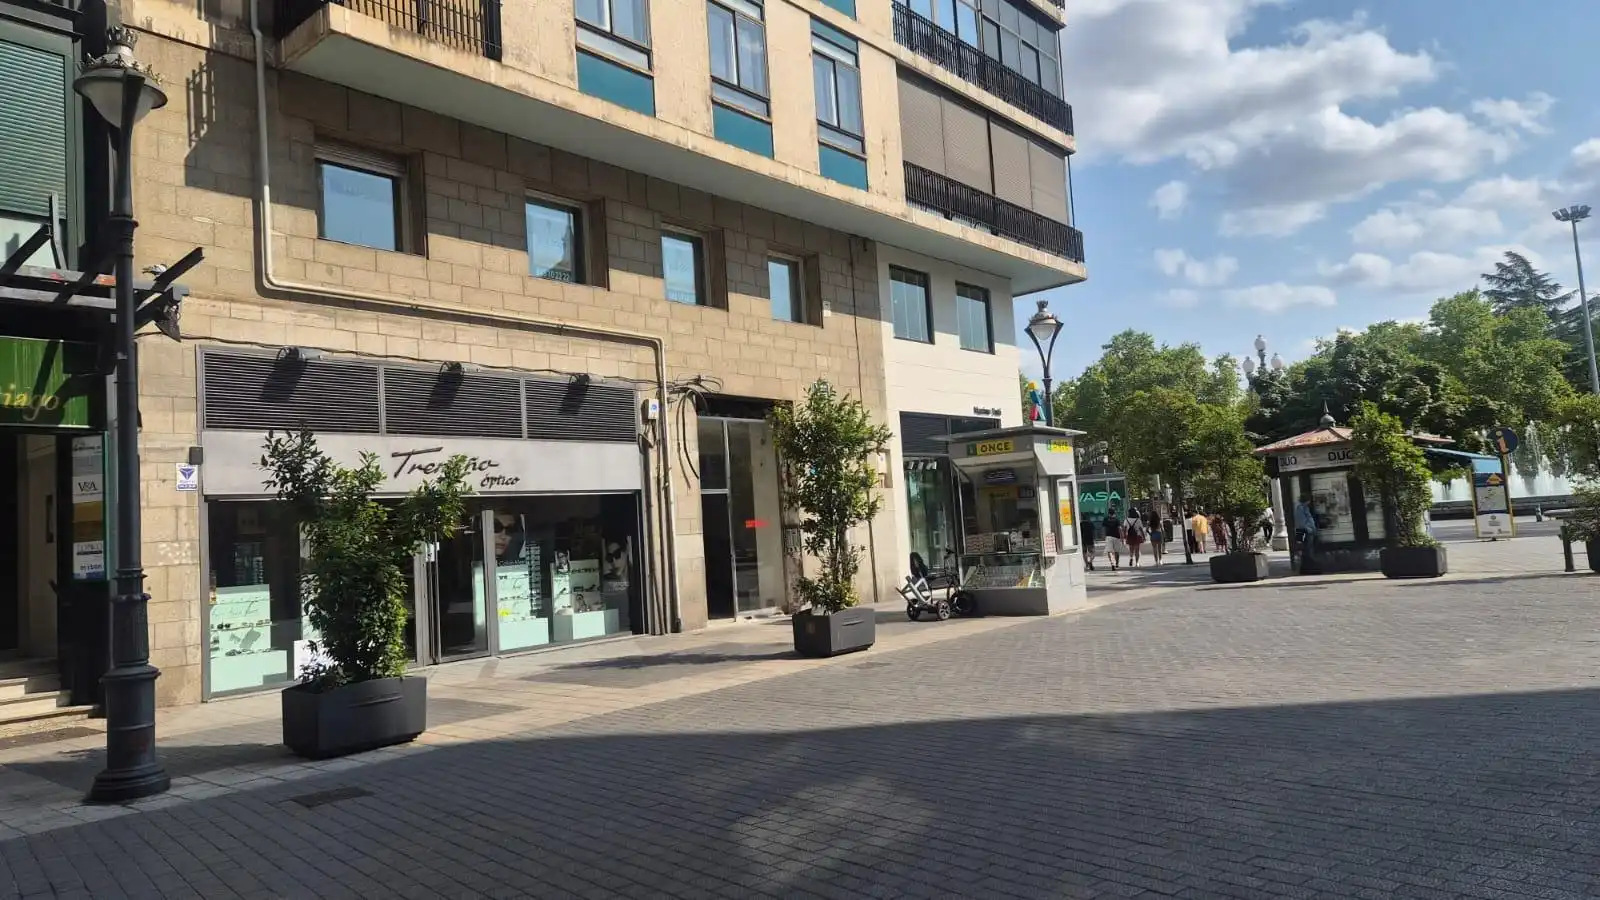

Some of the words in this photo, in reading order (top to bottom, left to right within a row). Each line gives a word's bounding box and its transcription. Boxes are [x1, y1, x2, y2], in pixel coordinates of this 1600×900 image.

[0, 384, 60, 421] iago
[980, 441, 1011, 453] ONCE
[391, 446, 499, 478] Treño
[480, 472, 521, 489] óptico
